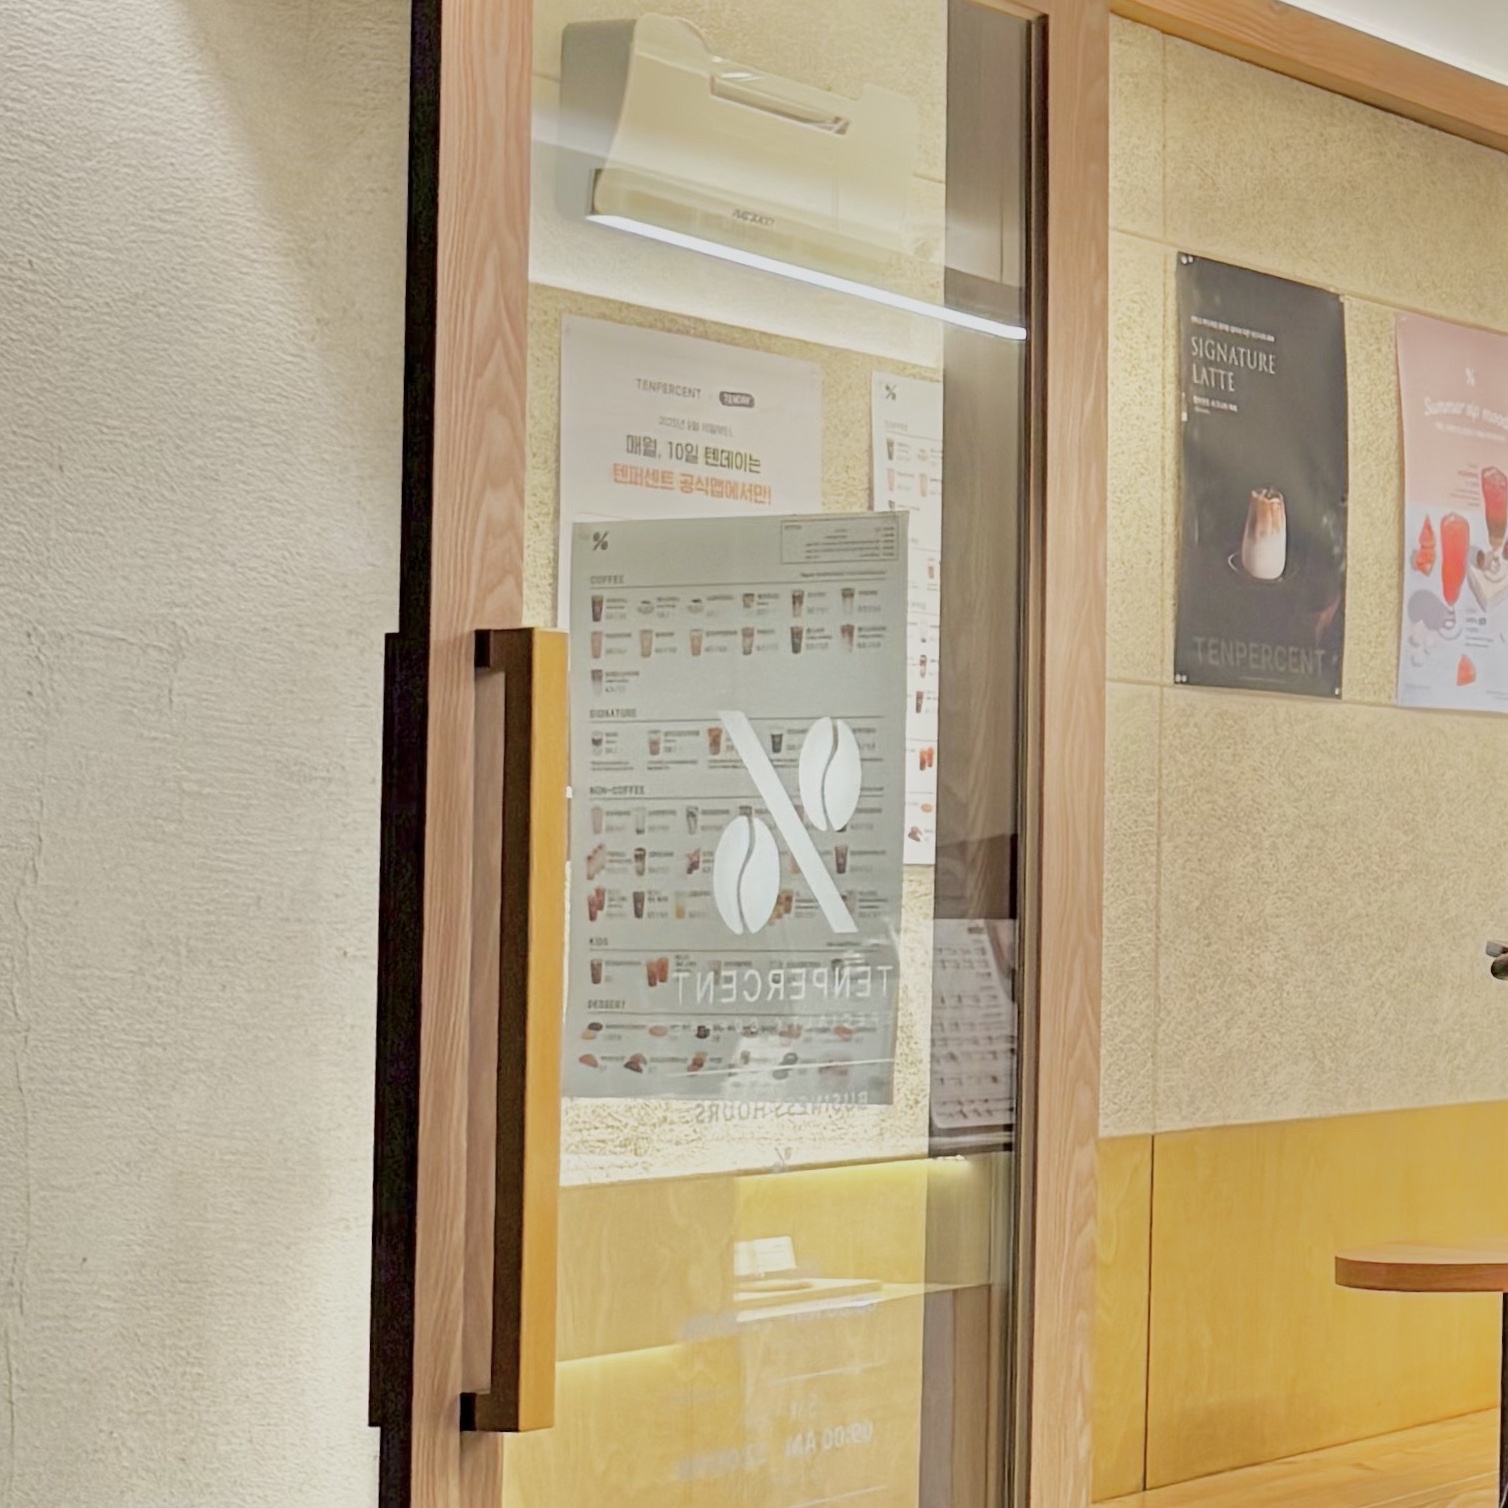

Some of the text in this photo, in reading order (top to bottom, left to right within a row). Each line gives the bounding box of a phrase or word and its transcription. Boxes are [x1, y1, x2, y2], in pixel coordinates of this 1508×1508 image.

[1190, 335, 1276, 375] SIGNATURE
[635, 377, 702, 400] TENPERCENT
[1192, 363, 1236, 392] LATTE
[626, 434, 762, 475] 매월, 10일 텐데이는
[612, 462, 676, 491] 텐퍼센트
[589, 574, 625, 585] COFFEE
[1192, 636, 1326, 677] TENPERCENT
